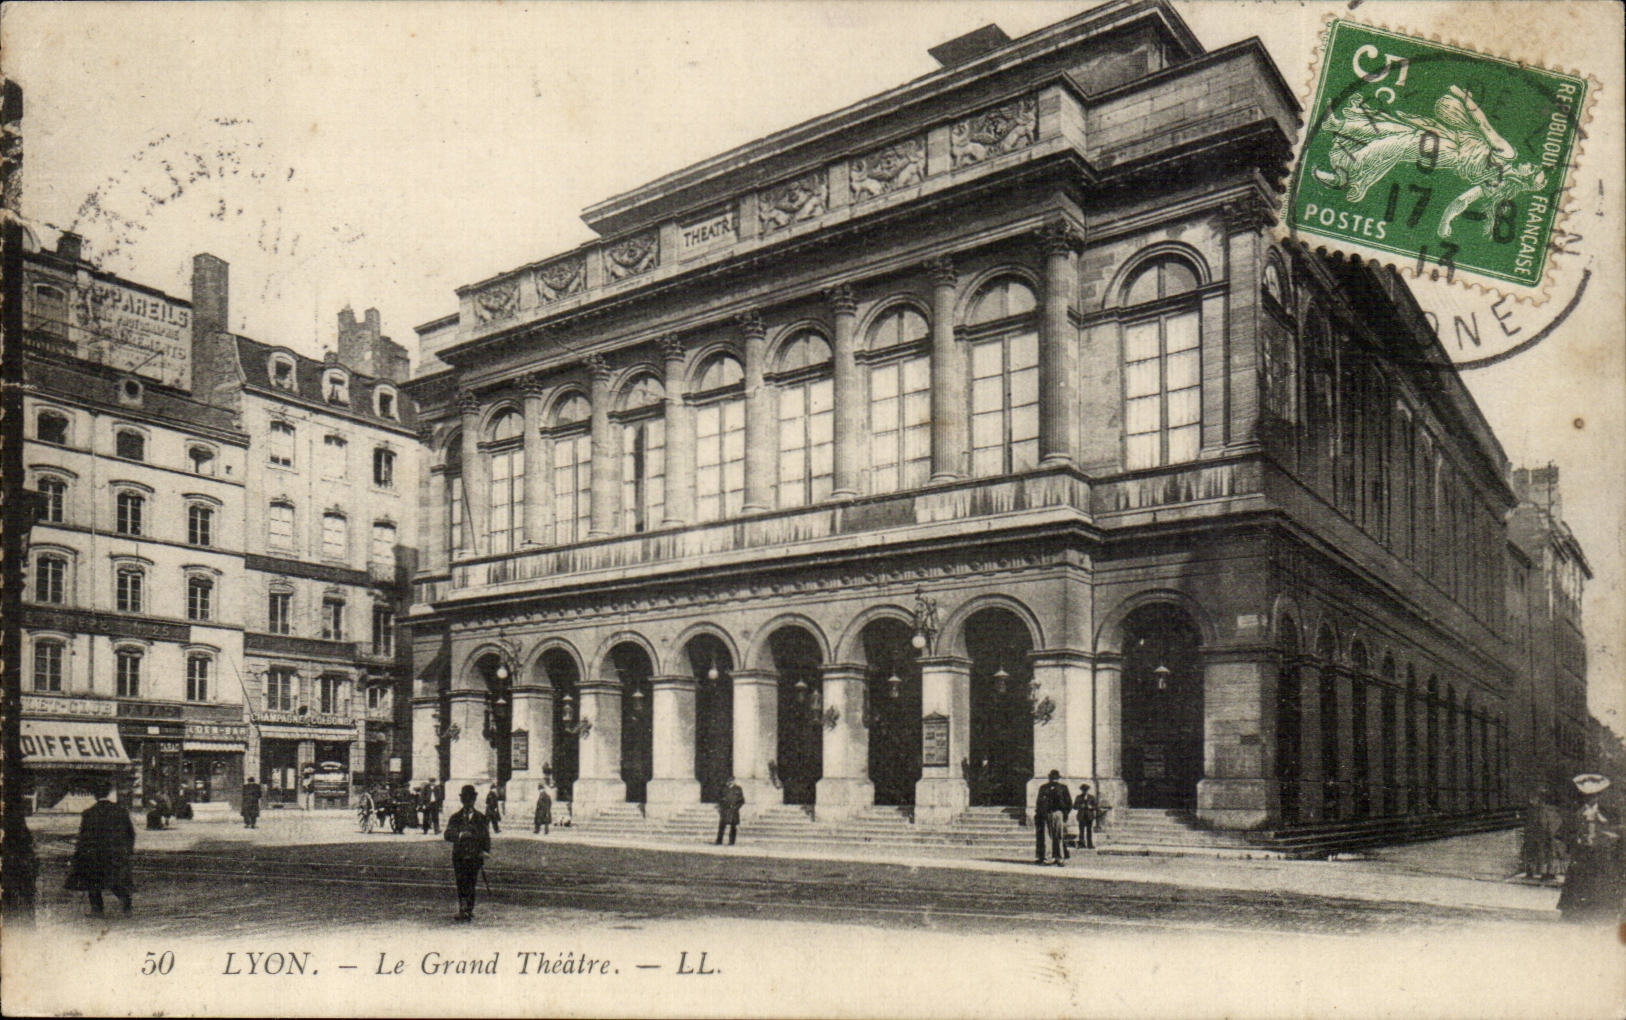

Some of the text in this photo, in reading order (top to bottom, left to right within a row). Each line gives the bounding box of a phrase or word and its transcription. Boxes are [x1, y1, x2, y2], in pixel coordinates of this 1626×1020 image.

[1304, 203, 1387, 239] POSTES
[1384, 183, 1432, 228] 17
[1514, 195, 1549, 276] FRANÇAISE
[20, 735, 120, 758] OIFFEUR
